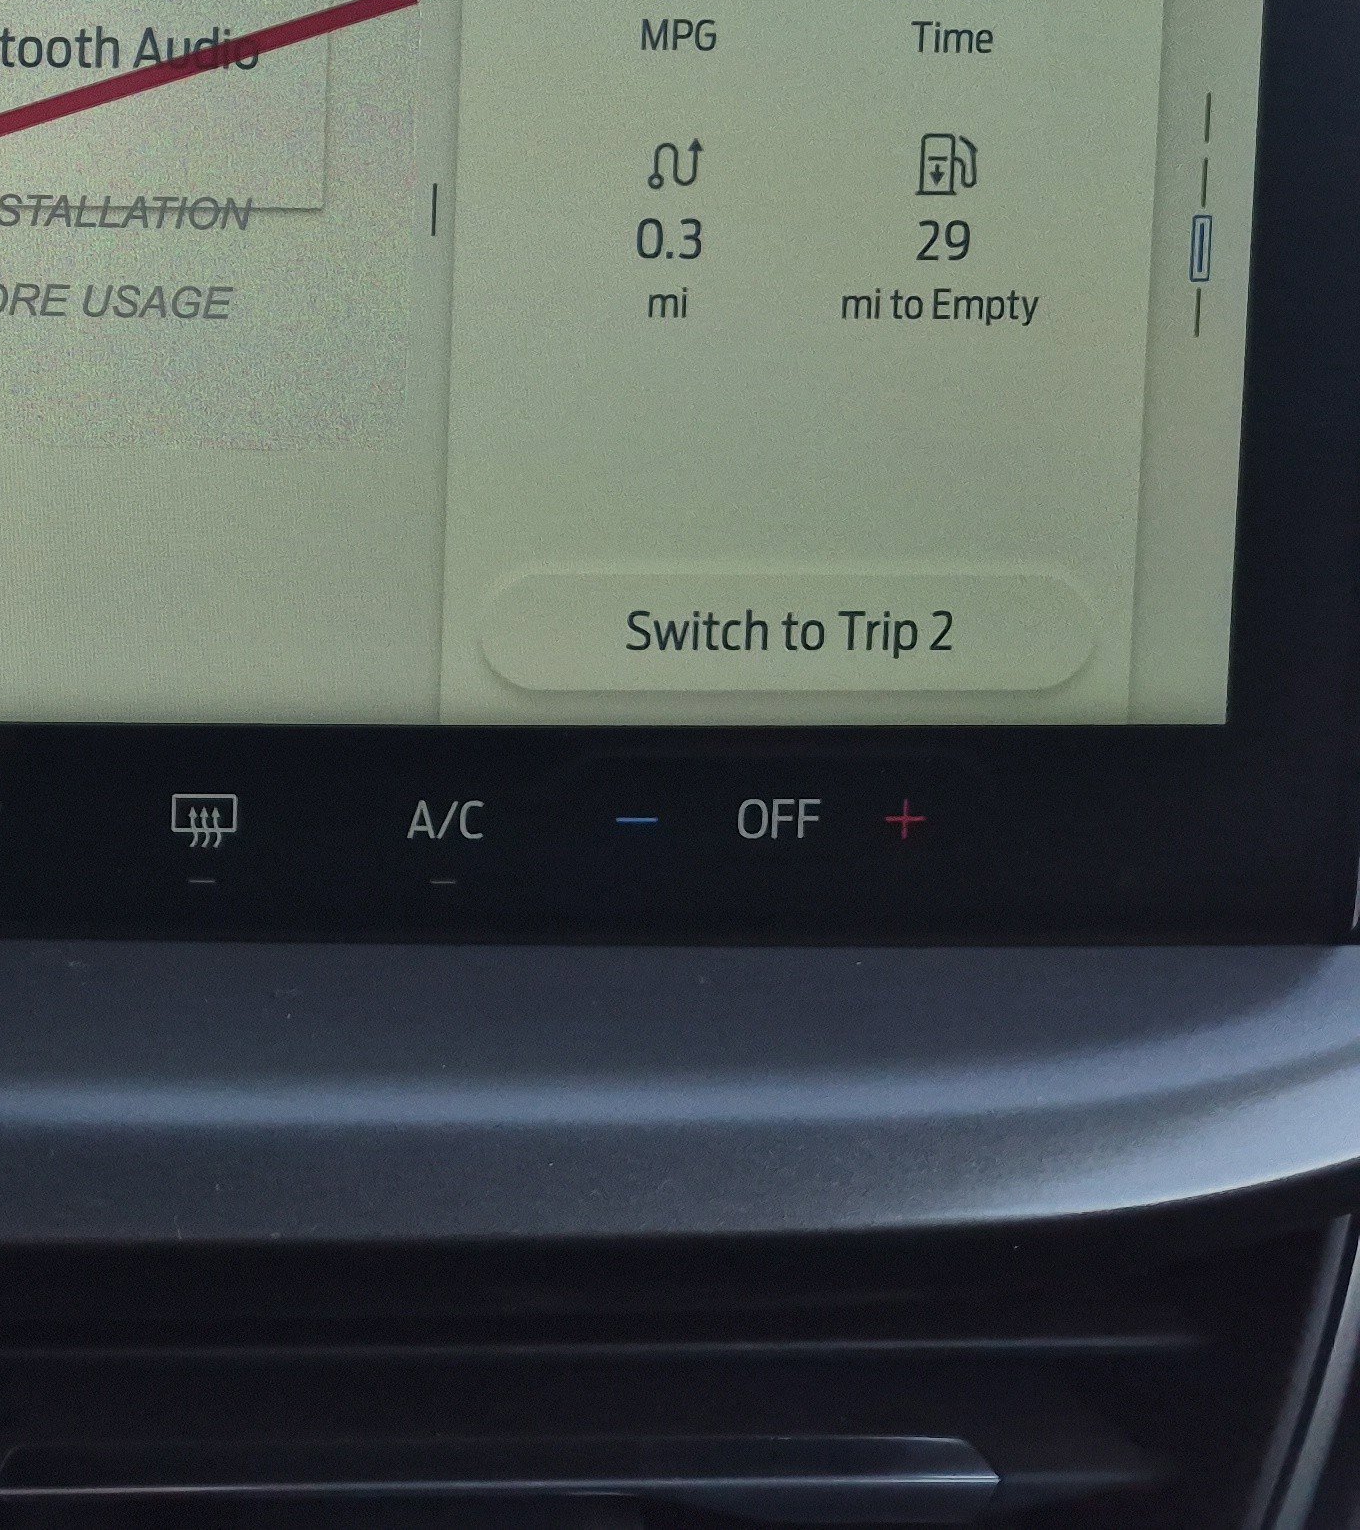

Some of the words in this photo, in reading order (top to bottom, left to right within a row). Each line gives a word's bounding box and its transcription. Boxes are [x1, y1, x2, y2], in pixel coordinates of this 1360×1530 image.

[640, 19, 718, 53] MPG
[912, 21, 994, 54] Time
[636, 217, 703, 260] 0.3
[916, 220, 971, 261] 29
[81, 284, 234, 319] USAGE
[648, 286, 688, 319] mi
[841, 289, 881, 320] mi
[890, 291, 924, 321] to
[932, 288, 1039, 326] Empty
[626, 610, 769, 652] Switch
[782, 615, 825, 652] to
[839, 610, 919, 659] Trip
[930, 611, 954, 651] 2
[407, 800, 484, 840] A/C
[736, 800, 821, 839] OFF
